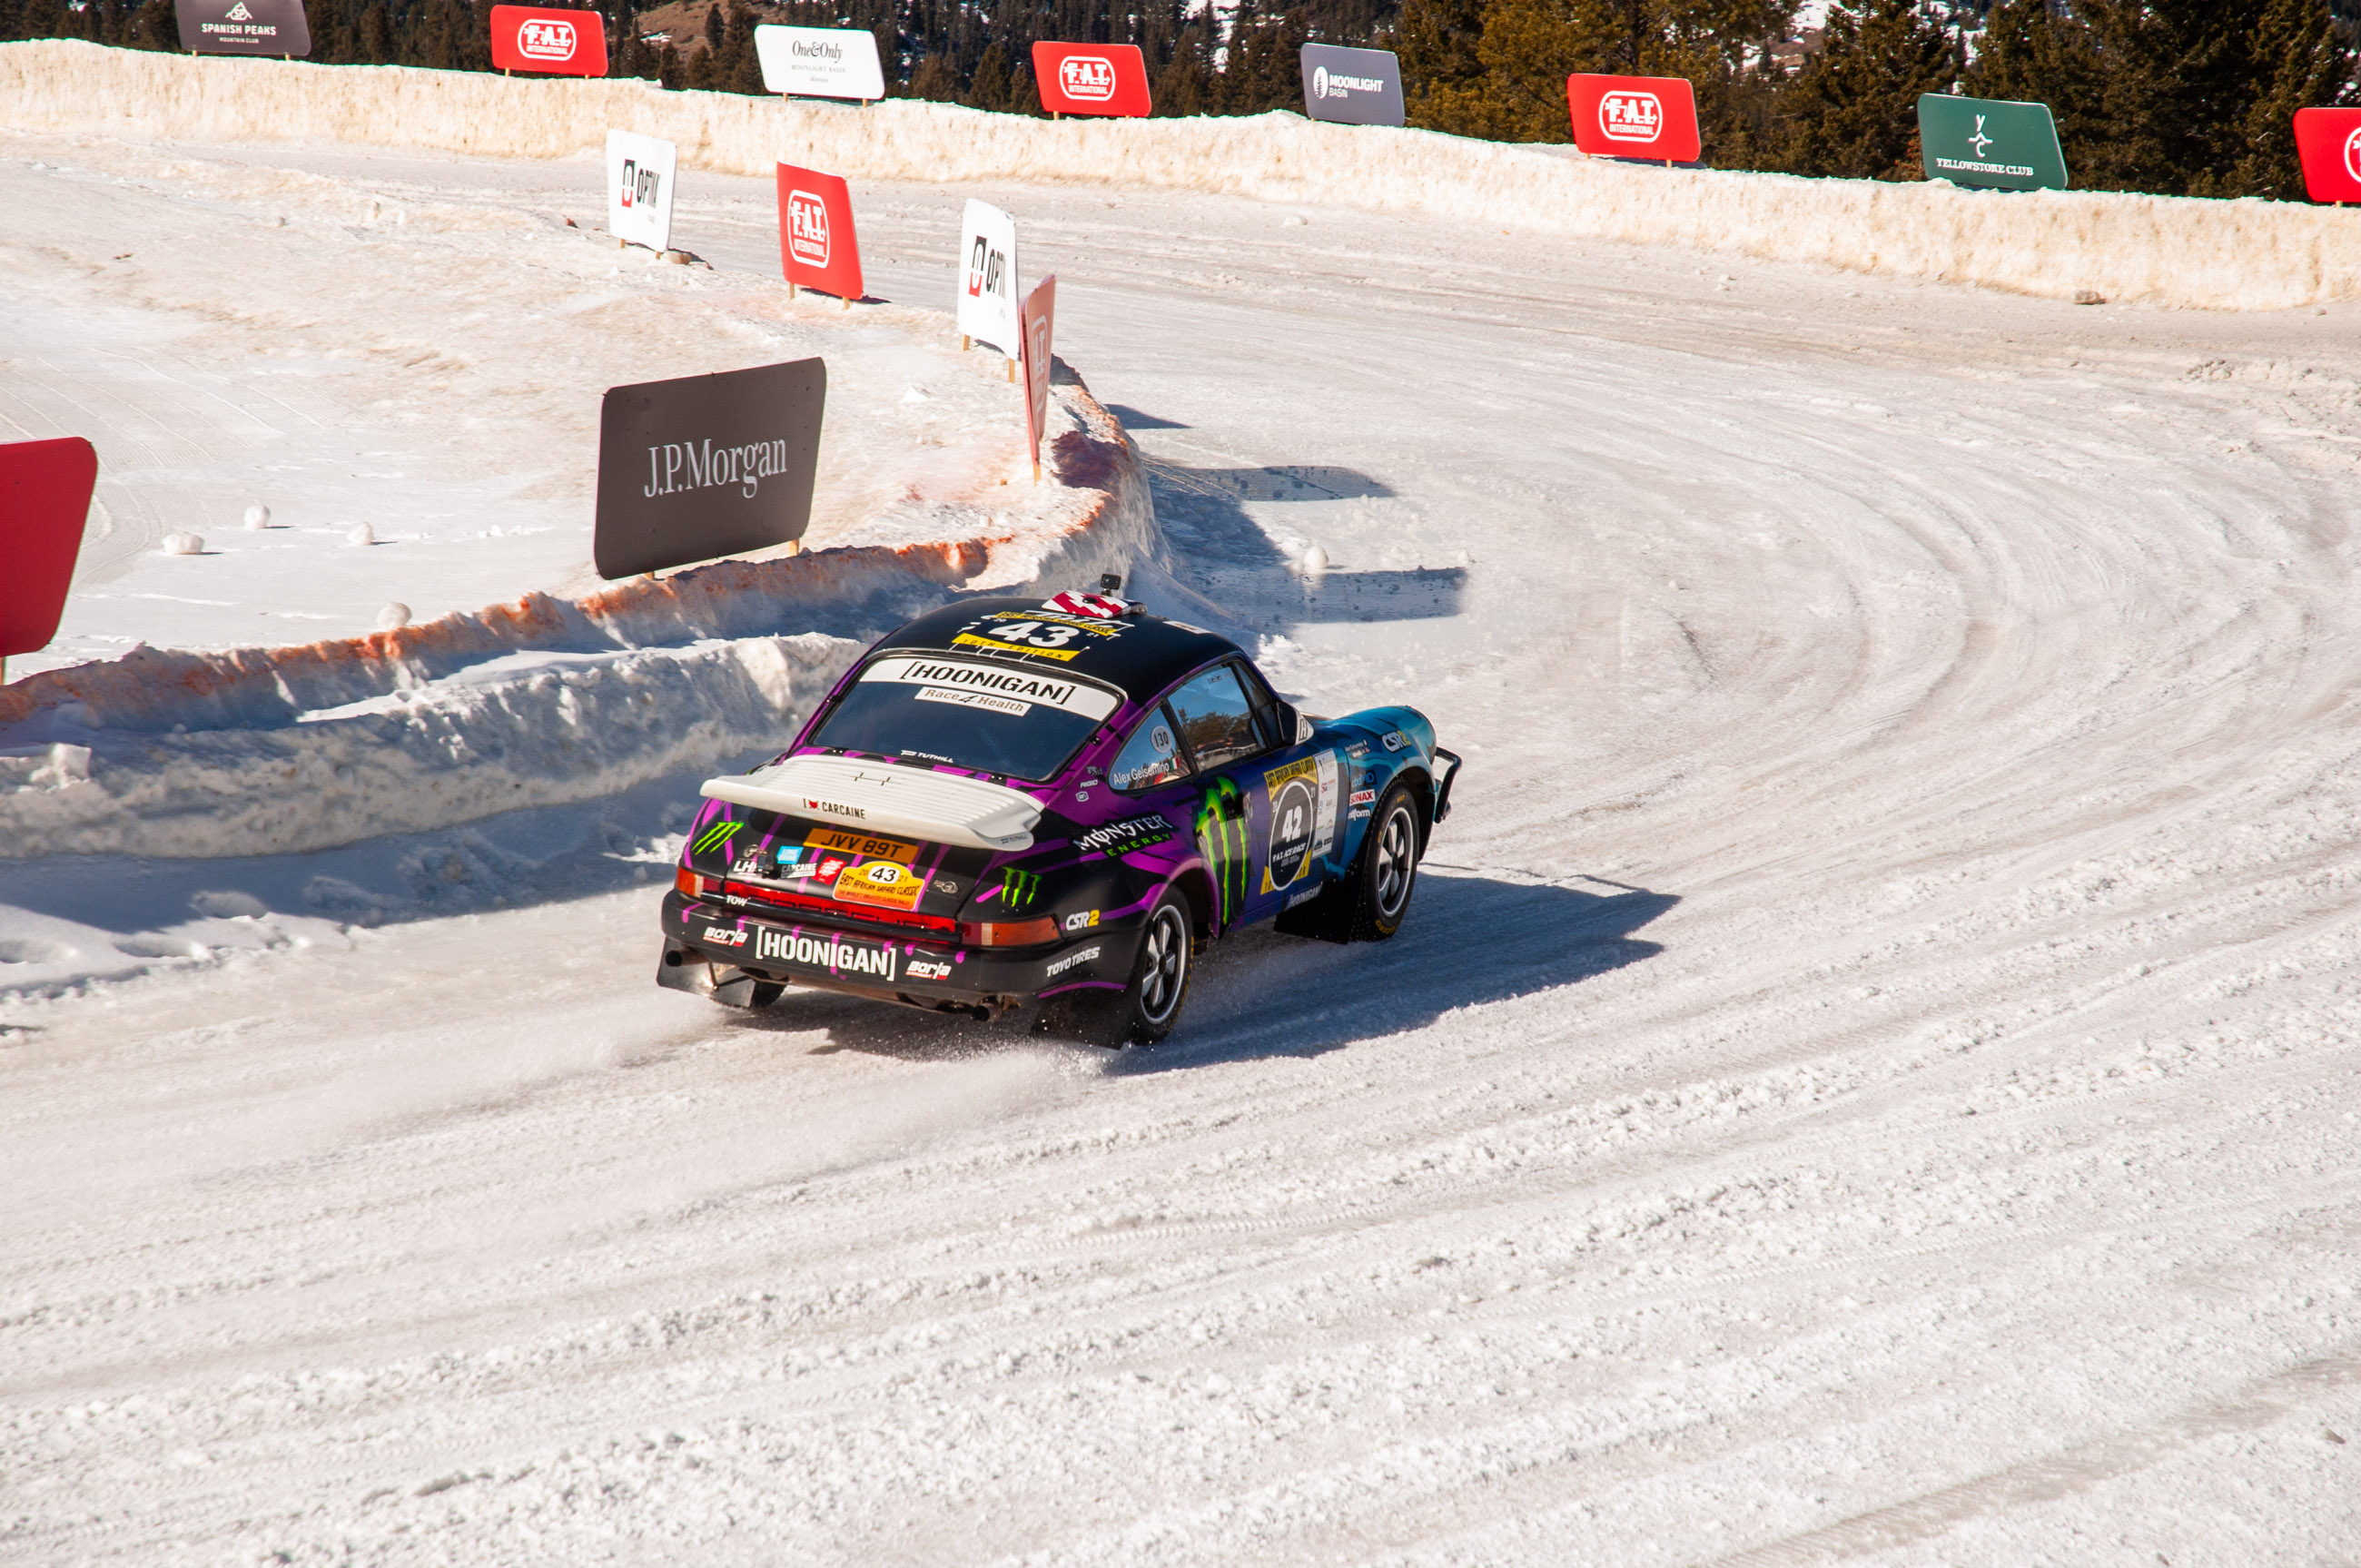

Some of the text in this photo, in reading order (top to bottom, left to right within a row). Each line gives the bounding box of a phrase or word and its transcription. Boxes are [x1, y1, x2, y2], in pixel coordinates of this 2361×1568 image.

[202, 24, 276, 35] SPANISH PEAKS
[527, 44, 568, 54] INTERNATIONAL
[792, 40, 843, 64] One&Only
[791, 64, 826, 73] MOONLIGHT
[1068, 84, 1108, 94] INTERNATIONAL
[1329, 74, 1384, 92] MOONLIGHT
[1329, 87, 1348, 97] BASIN
[1609, 123, 1654, 134] INTERNATIONAL
[1936, 157, 2034, 176] YELLOWSTONE CLUB
[644, 439, 787, 498] J.P.Morgan
[988, 621, 1080, 647] 43
[963, 638, 1063, 659] 10TH EDITION
[1153, 731, 1170, 748] 130
[1382, 730, 1411, 753] CSR2
[917, 752, 953, 763] TUTHILL
[1113, 771, 1132, 785] Alex
[1350, 791, 1374, 804] SONAX
[803, 798, 866, 820] I CARCAINE
[1073, 814, 1172, 851] MONSTER
[1281, 805, 1302, 843] 42
[820, 833, 904, 858] JVV 89T
[1106, 833, 1171, 857] ENERGY
[781, 863, 817, 873] CARCAINE
[872, 868, 896, 882] 43
[840, 873, 921, 896] EAST AFRICAN SAFARI CLASSIC
[726, 894, 748, 906] TOW
[1066, 910, 1100, 931] CSR2
[1046, 947, 1101, 977] TOYO TIRES
